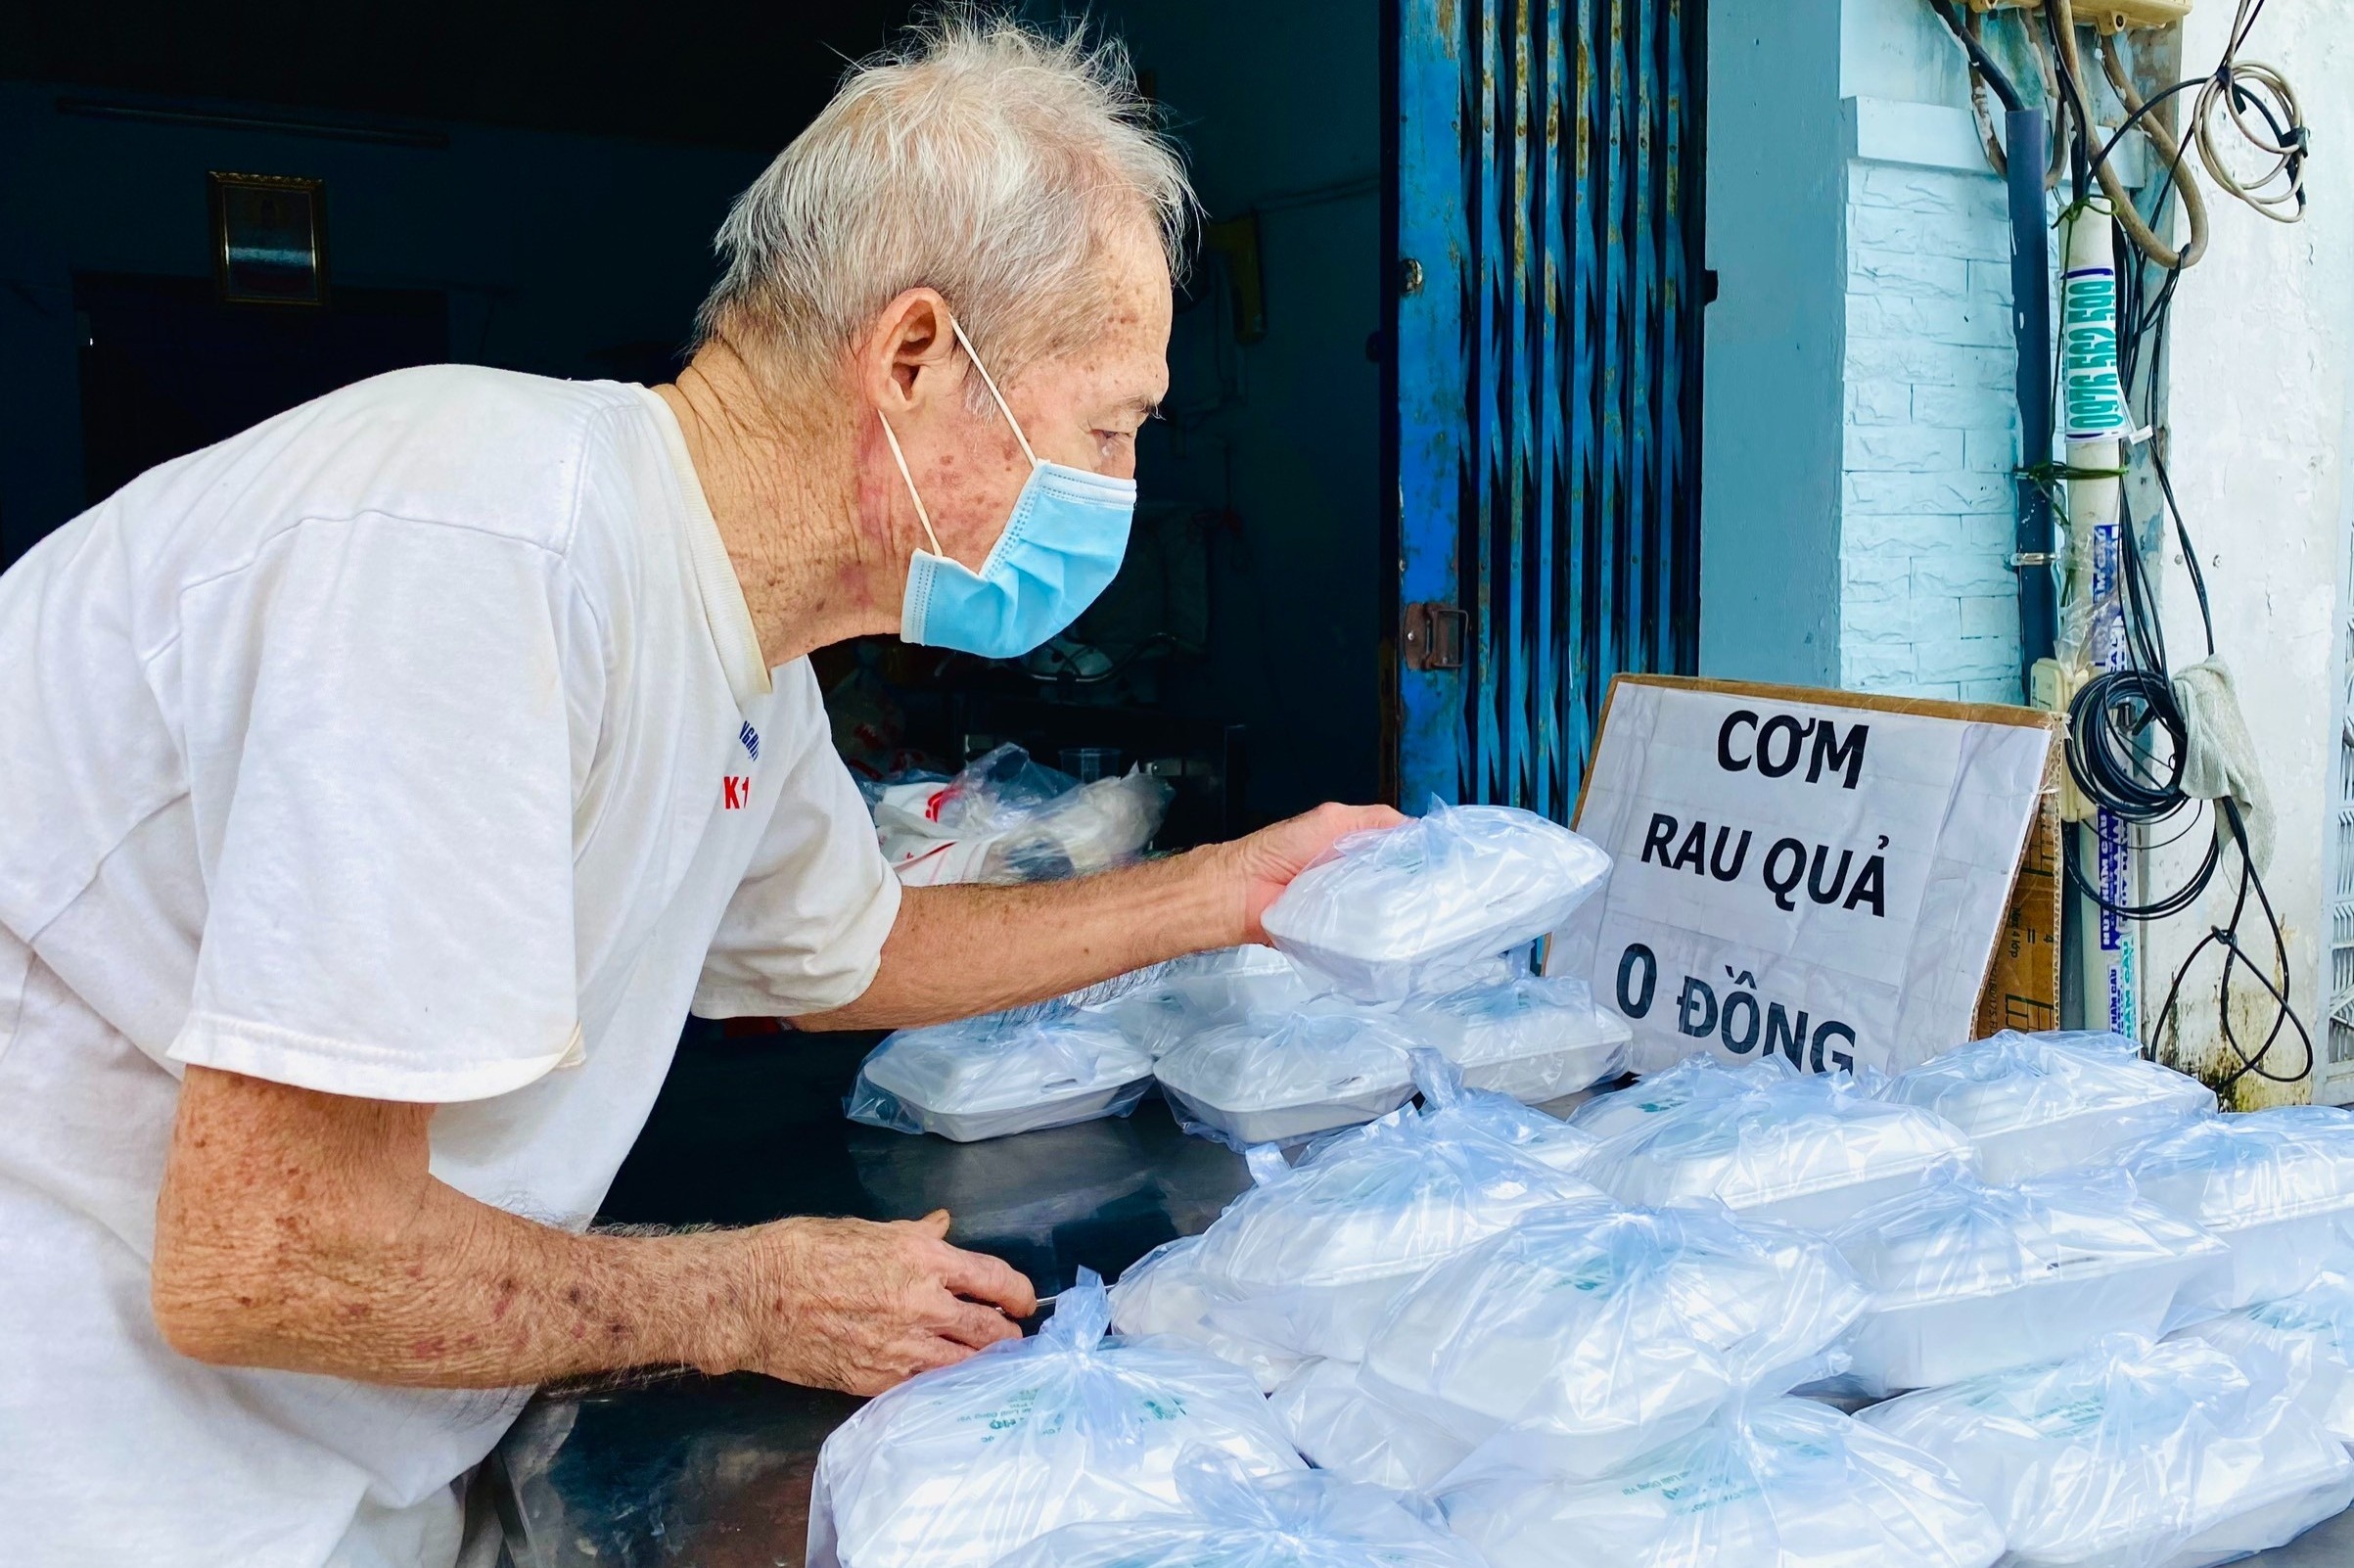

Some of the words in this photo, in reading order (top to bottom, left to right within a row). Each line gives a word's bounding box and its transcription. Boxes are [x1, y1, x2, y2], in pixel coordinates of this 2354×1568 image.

[2067, 280, 2116, 324] 599
[2068, 328, 2117, 370] 562
[2068, 375, 2124, 429] 0976
[1717, 710, 1869, 790] CƠM
[1640, 813, 1752, 882] RAU
[1762, 834, 1890, 918] QUẢ
[1616, 943, 1657, 1020] 0
[1676, 964, 1857, 1077] ĐỒNG
